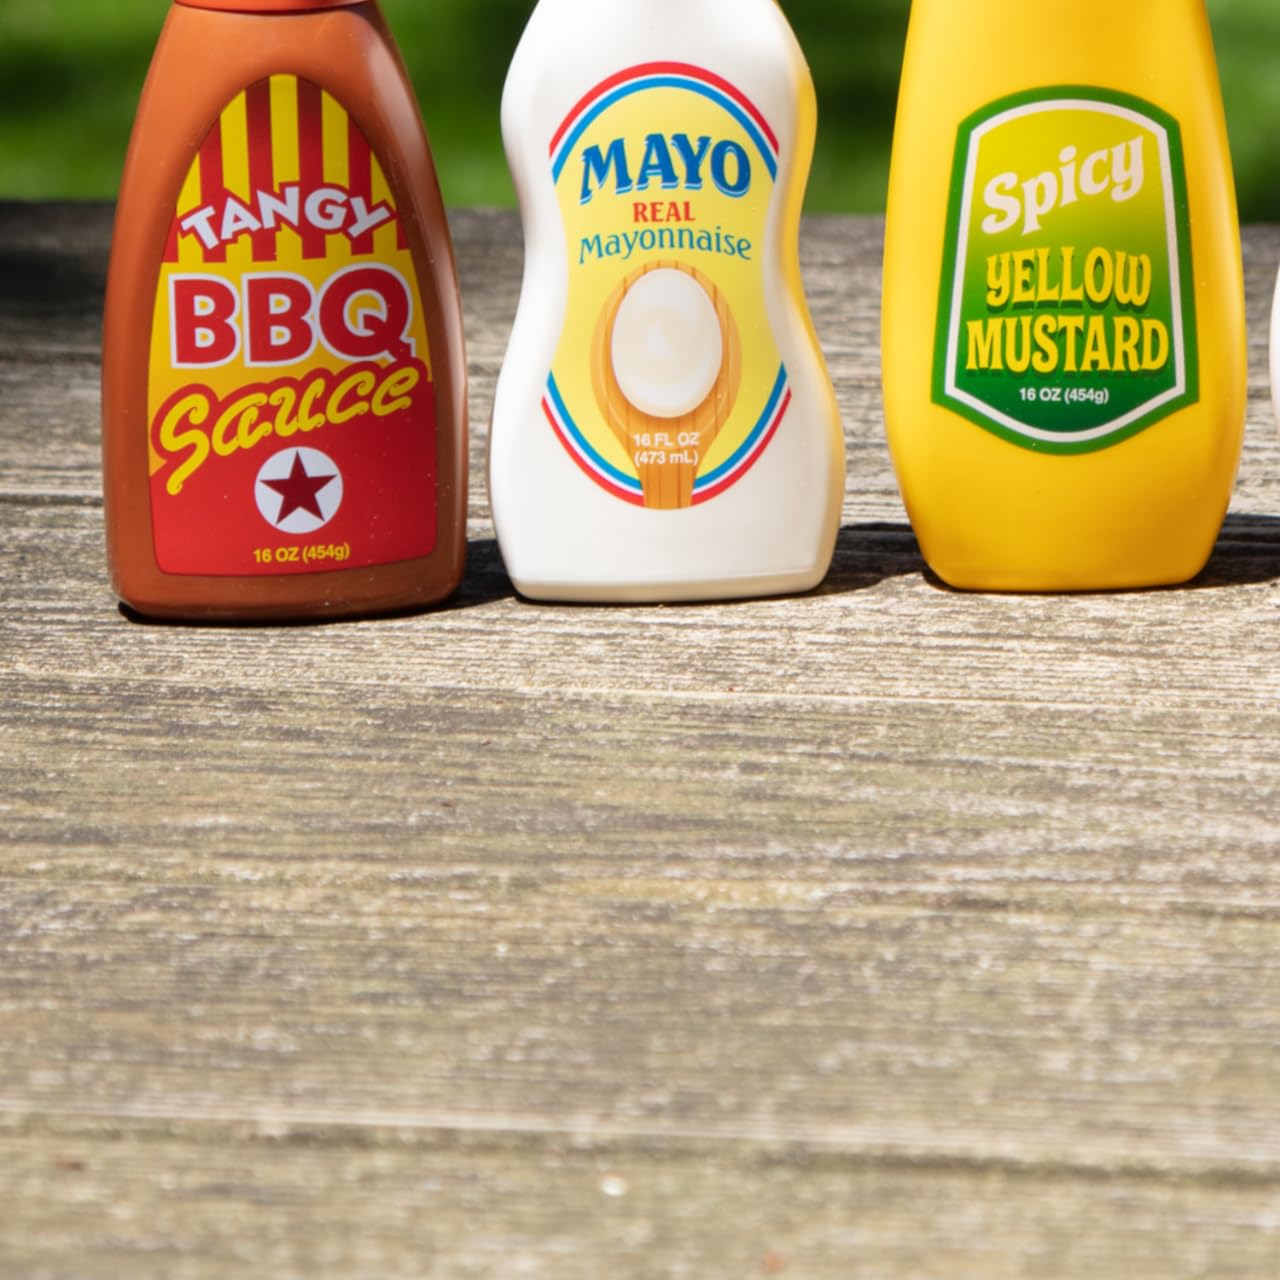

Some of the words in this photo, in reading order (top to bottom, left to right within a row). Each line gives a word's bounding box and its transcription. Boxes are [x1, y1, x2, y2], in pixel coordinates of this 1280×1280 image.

[579, 133, 752, 204] MAYO
[981, 136, 1144, 235] Spicy
[181, 185, 393, 250] TANGY
[633, 202, 696, 222] REAL
[579, 225, 752, 264] Mayonnaise
[986, 246, 1152, 308] YELLOW
[167, 262, 416, 368] BBQ
[966, 314, 1170, 375] MUSTARD
[1019, 387, 1037, 401] 16
[1039, 387, 1062, 401] OZ
[1064, 386, 1110, 405] (454g)
[159, 367, 416, 495] Sauce
[633, 432, 651, 448] 16
[653, 431, 674, 448] FL
[677, 431, 700, 447] OZ
[634, 450, 666, 467] (473
[669, 449, 699, 467] mL)
[253, 548, 272, 563] 16
[275, 546, 300, 562] OZ
[302, 541, 351, 565] (454g)
